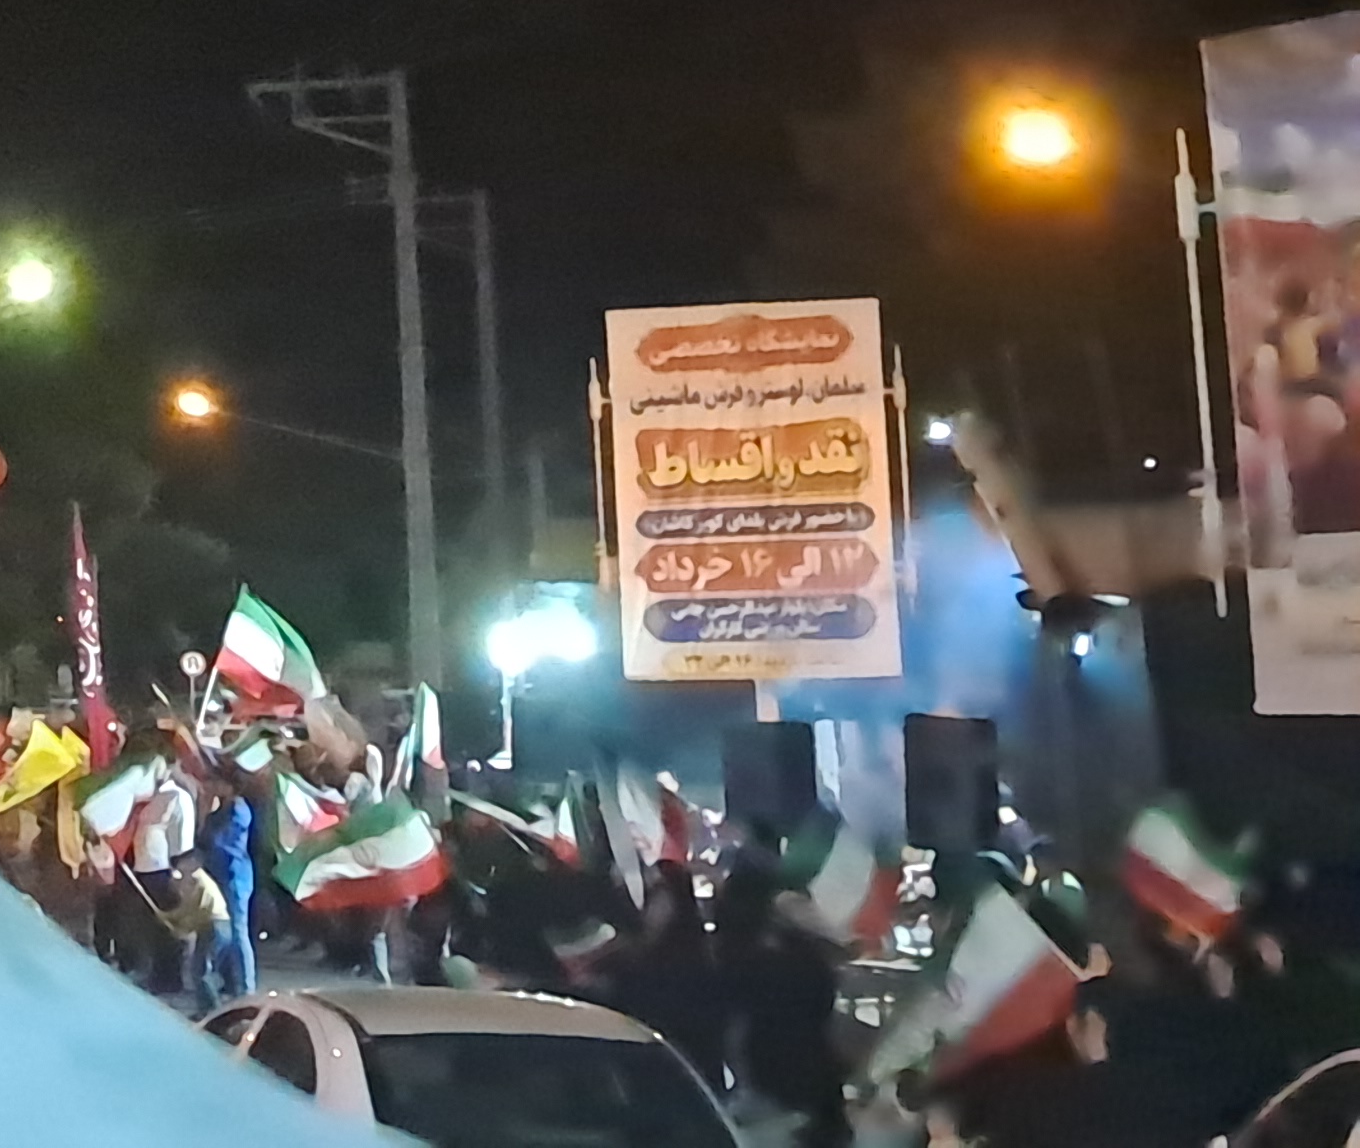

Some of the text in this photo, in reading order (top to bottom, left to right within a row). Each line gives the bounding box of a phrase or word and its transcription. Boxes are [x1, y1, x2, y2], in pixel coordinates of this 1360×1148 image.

[630, 383, 701, 415] ماشینی
[747, 388, 757, 407] و
[648, 428, 862, 489] نقد و اقساط
[652, 549, 732, 591] خرداد
[740, 548, 773, 579] ۱۶
[776, 546, 821, 587] الی
